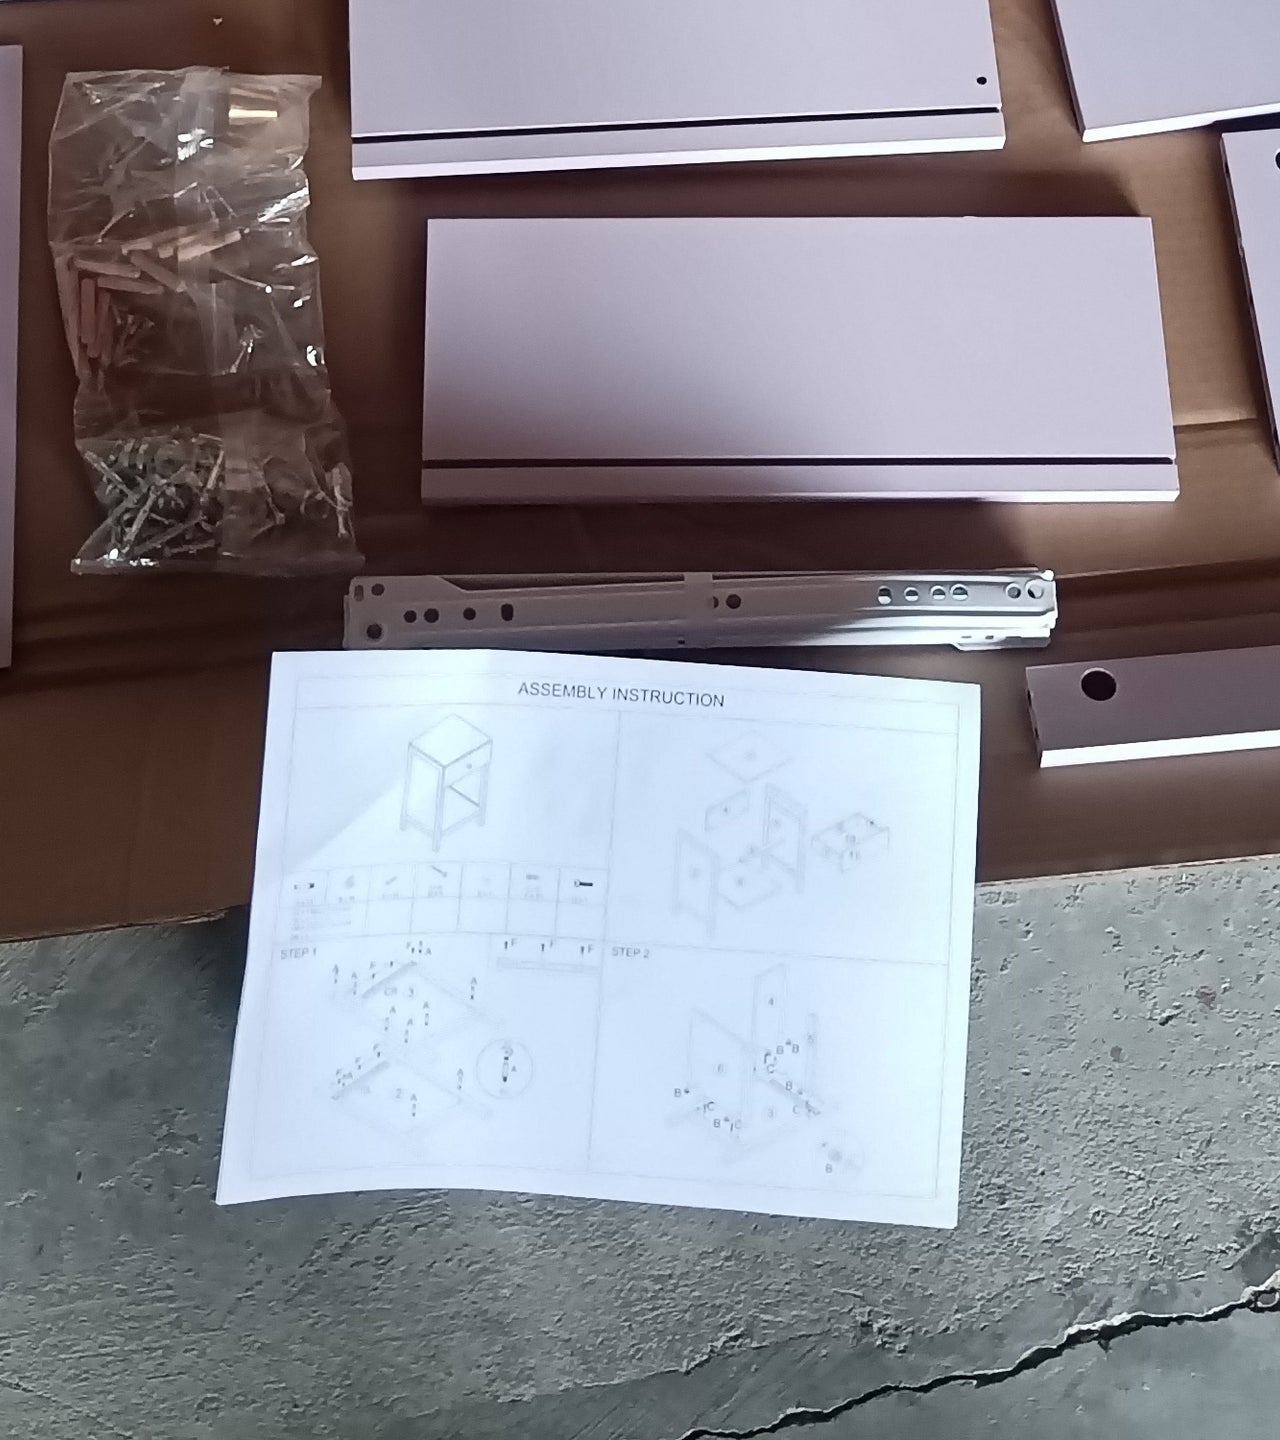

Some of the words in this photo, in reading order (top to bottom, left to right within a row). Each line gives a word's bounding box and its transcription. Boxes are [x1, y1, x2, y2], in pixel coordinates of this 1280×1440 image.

[518, 682, 608, 700] ASSEMBLY
[612, 688, 725, 707] INSTRUCTION
[280, 947, 309, 960] STEP
[424, 946, 432, 956] A
[612, 946, 641, 958] STEP
[643, 949, 650, 959] 2
[389, 1005, 397, 1015] A
[422, 1000, 430, 1010] A
[406, 1017, 414, 1027] A
[776, 1045, 784, 1055] B
[792, 1044, 799, 1054] B
[785, 1081, 793, 1091] B
[674, 1087, 682, 1098] B
[713, 1118, 721, 1128] B
[825, 1163, 833, 1174] B
